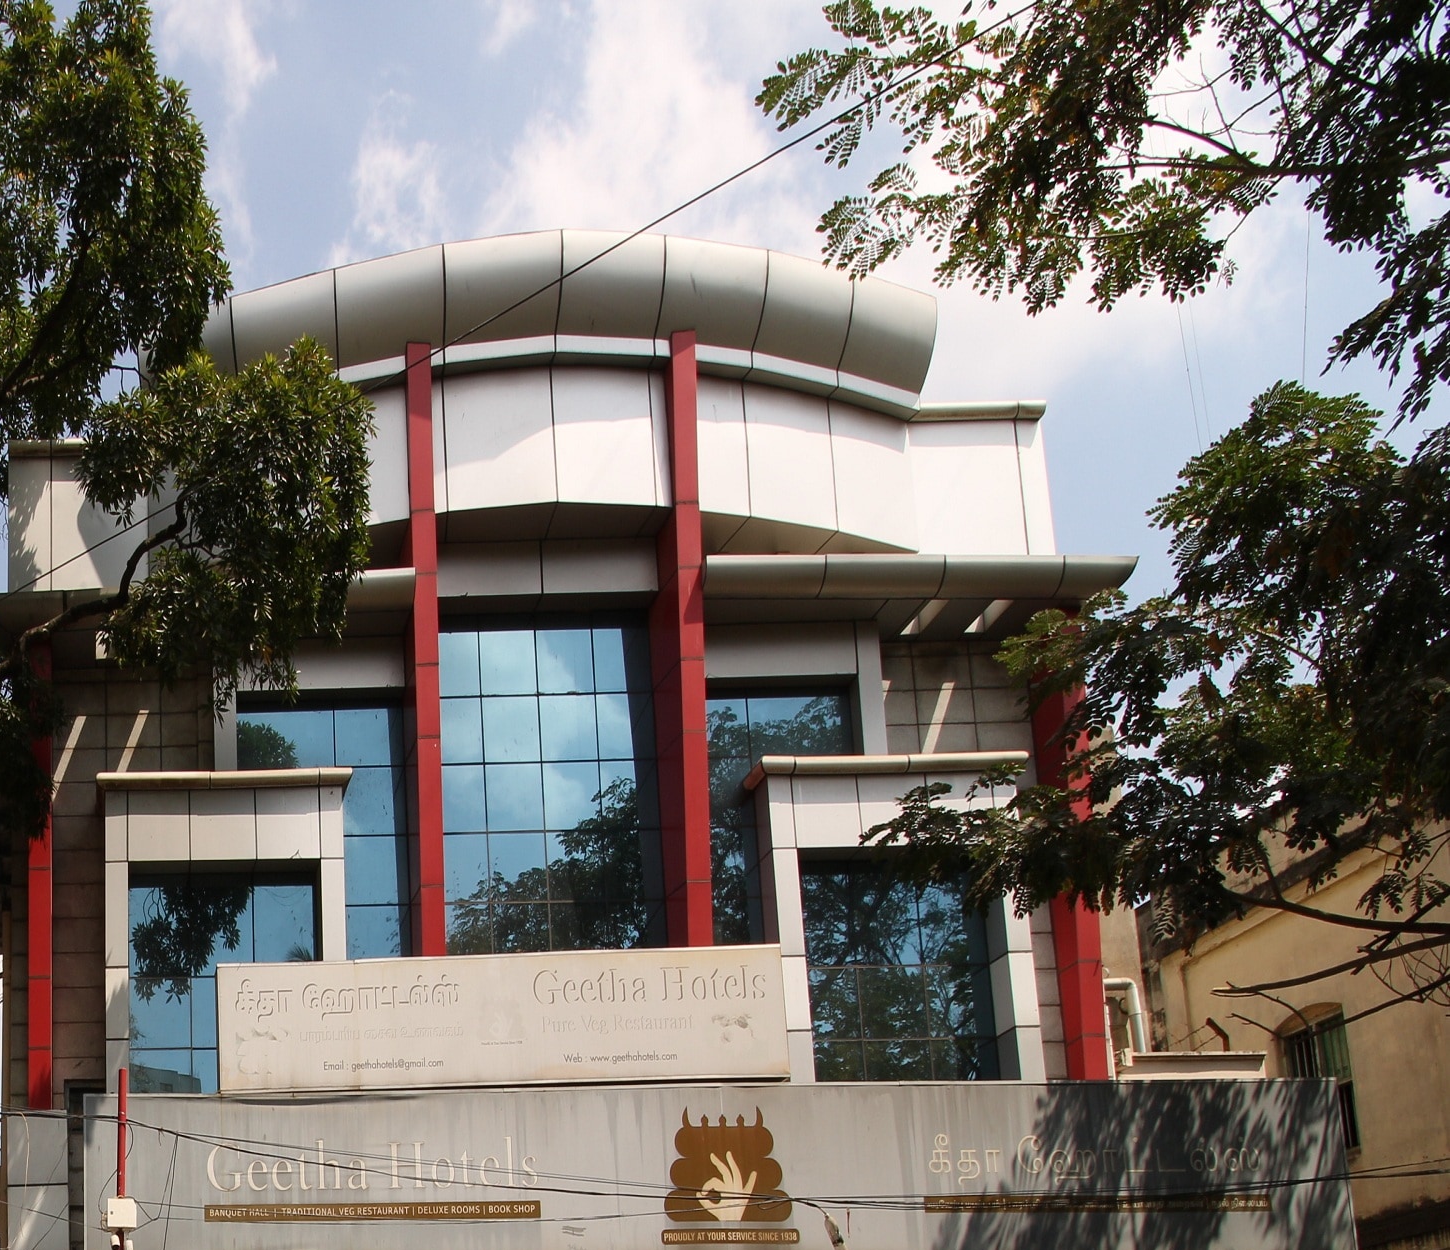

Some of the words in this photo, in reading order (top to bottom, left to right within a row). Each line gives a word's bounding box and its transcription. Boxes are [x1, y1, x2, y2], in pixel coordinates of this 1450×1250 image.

[533, 968, 647, 1005] Geetha
[660, 965, 767, 1001] Hotels
[541, 1016, 576, 1033] Pure
[580, 1015, 609, 1035] Veg
[613, 1013, 694, 1031] Restaurant
[323, 1059, 344, 1071] Email
[351, 1057, 444, 1073] geethahotels@gmail.com
[563, 1053, 583, 1064] Web
[590, 1051, 678, 1065] www.geethahotels.com
[206, 1139, 370, 1193] Geetha
[387, 1136, 539, 1190] Hotels
[928, 1132, 1003, 1187] கீதா
[209, 1208, 247, 1219] BANQUET
[249, 1208, 269, 1217] HALL
[281, 1207, 337, 1216] TRADITIONAL
[338, 1207, 355, 1216] VEG
[357, 1206, 410, 1216] RESTAURANT
[417, 1205, 449, 1215] DELUXE
[451, 1205, 480, 1215] ROOMS
[488, 1204, 512, 1214] BOOK
[513, 1204, 536, 1214] SHOP
[663, 1232, 695, 1241] PROUDLY
[697, 1232, 706, 1241] AT
[706, 1232, 726, 1241] YOUR
[727, 1232, 757, 1241] SERVICE
[757, 1232, 779, 1241] SINCE
[780, 1231, 798, 1241] 1938
